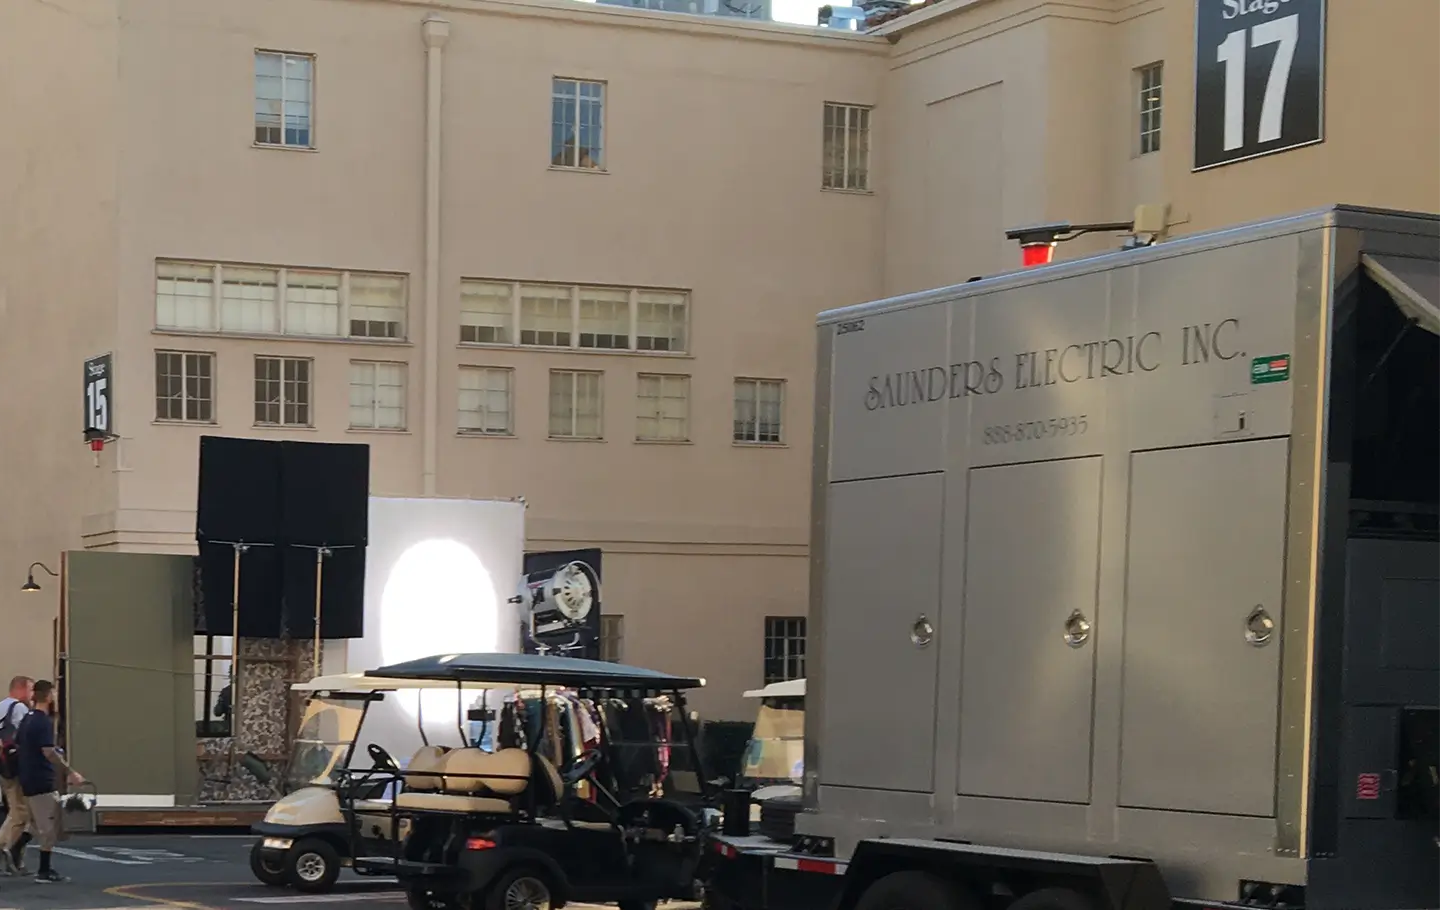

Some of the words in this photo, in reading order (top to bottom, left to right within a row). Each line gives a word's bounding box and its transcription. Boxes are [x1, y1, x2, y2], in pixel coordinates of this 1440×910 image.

[1221, 0, 1291, 19] Stag
[1216, 13, 1299, 151] 17
[864, 356, 1003, 411] SAUNDERS
[1014, 331, 1162, 390] ELECTRIC
[1181, 318, 1247, 366] INC.
[87, 378, 108, 431] 15
